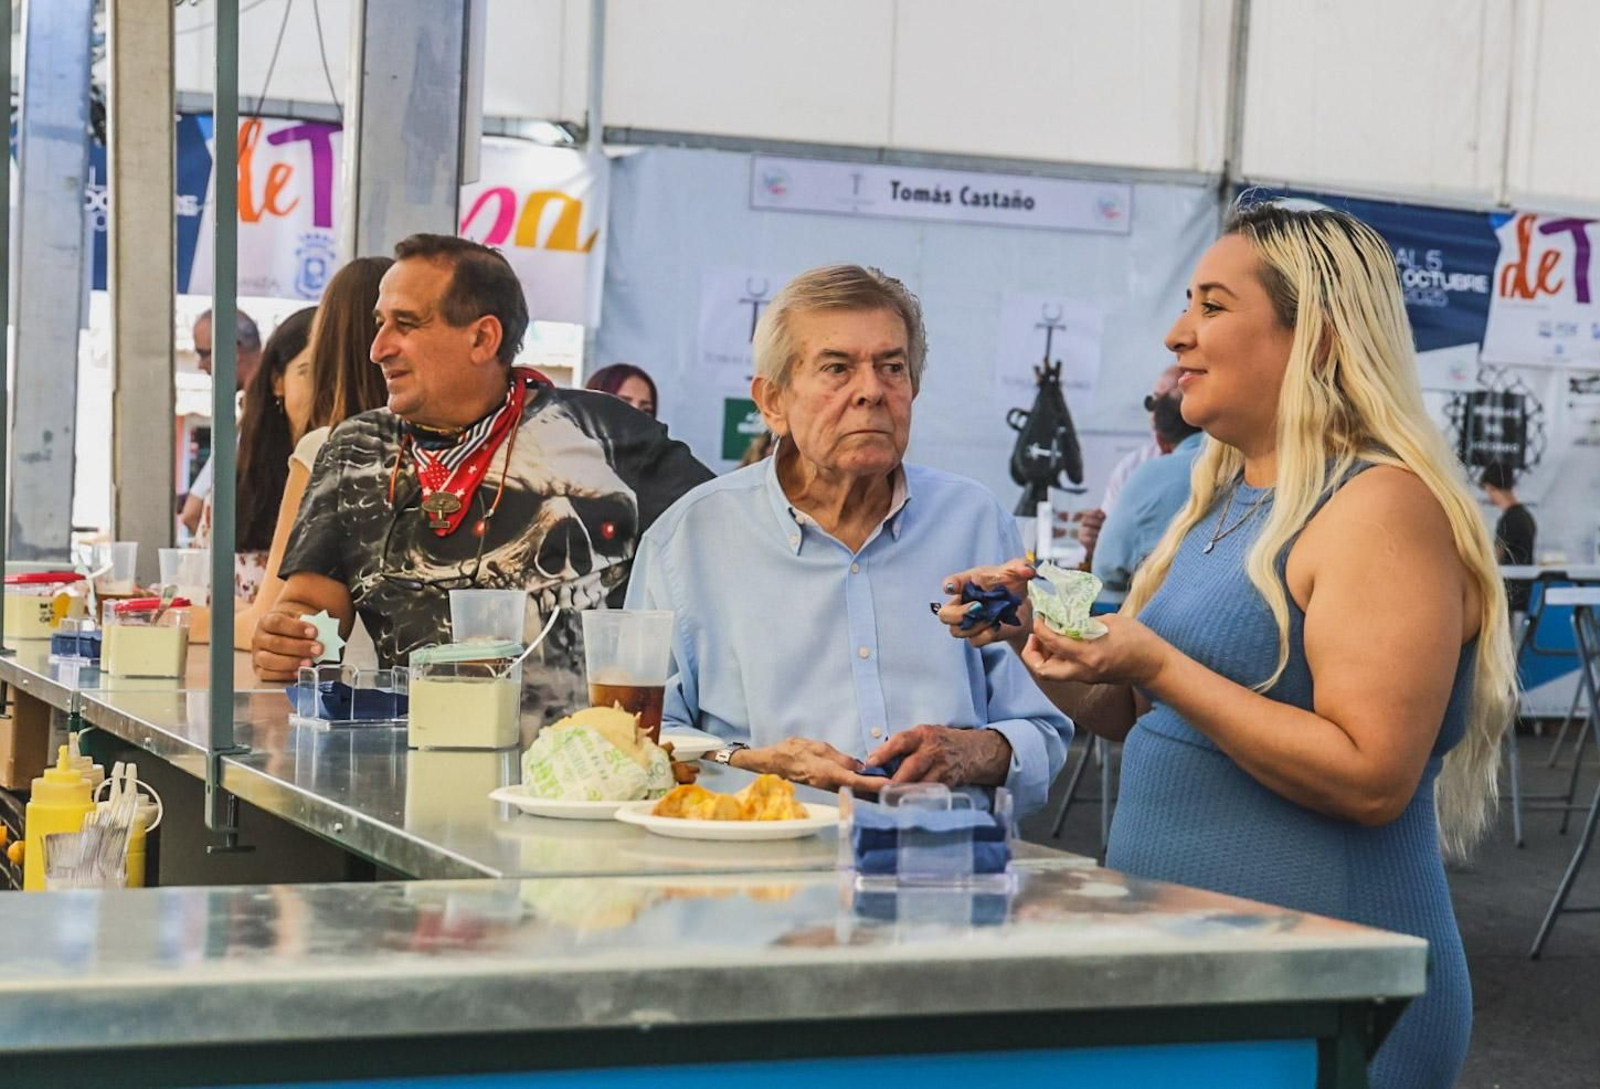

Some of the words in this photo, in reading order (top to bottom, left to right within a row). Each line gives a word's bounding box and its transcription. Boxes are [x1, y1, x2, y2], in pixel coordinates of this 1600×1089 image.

[891, 180, 952, 205] Tomás
[959, 185, 1035, 212] Castaño
[1425, 249, 1442, 271] 5
[1402, 268, 1488, 295] OCTUBRE
